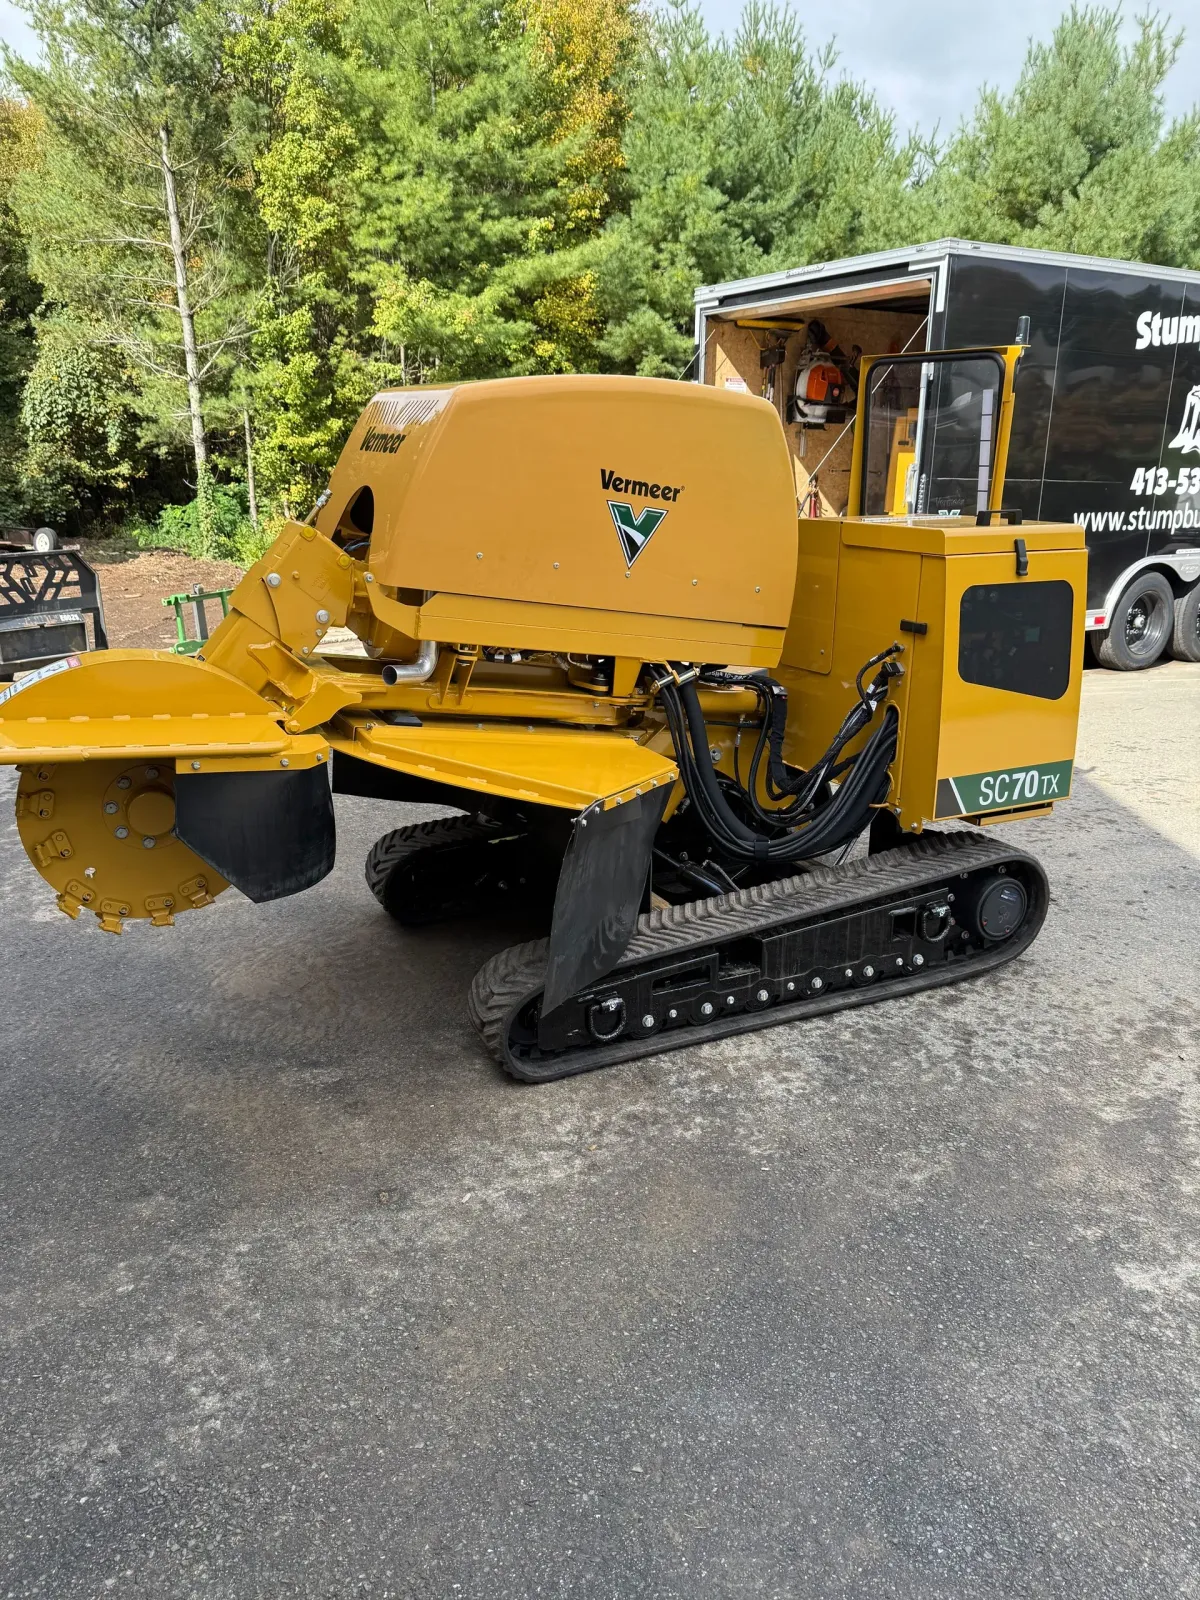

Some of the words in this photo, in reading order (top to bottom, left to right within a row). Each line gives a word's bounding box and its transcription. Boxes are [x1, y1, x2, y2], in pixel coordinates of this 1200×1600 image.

[1135, 310, 1200, 352] Stum
[360, 426, 407, 454] Vermeer
[600, 468, 681, 502] Vermeer
